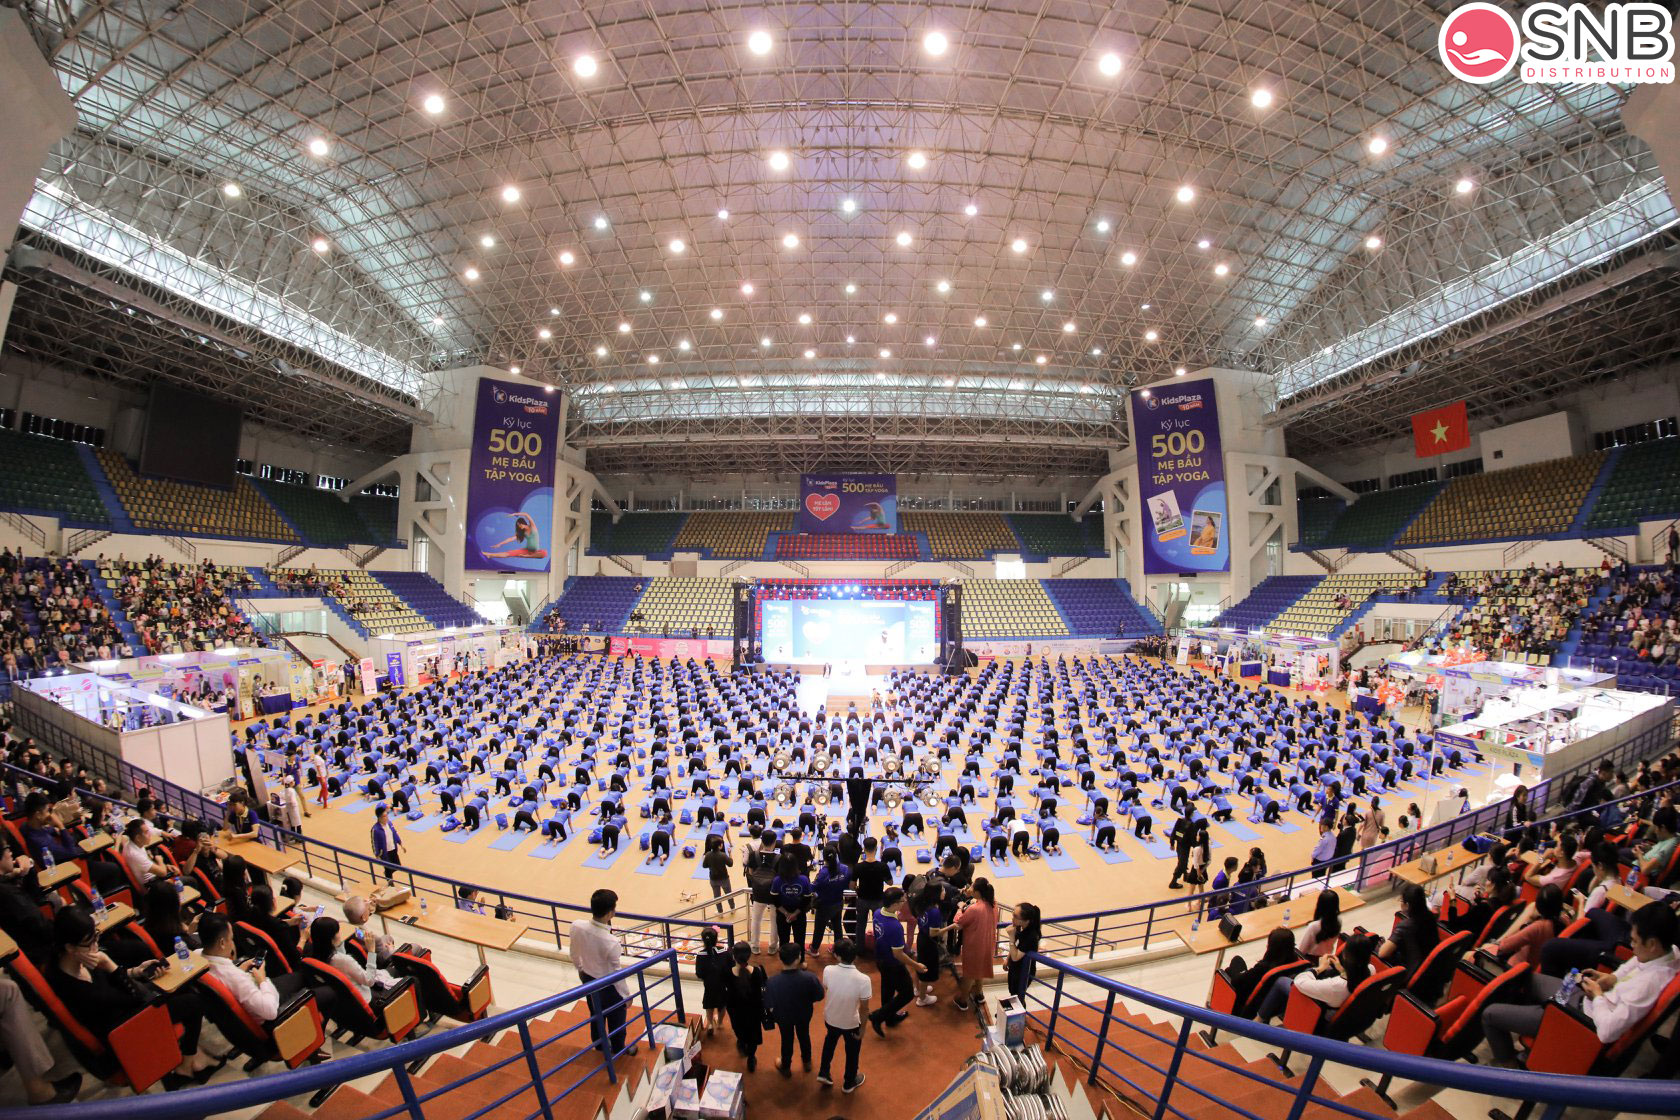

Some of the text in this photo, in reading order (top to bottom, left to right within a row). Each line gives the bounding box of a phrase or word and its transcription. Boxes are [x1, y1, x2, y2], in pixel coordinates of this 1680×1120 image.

[508, 395, 548, 407] KidsPlaza
[1161, 394, 1202, 406] KidsPlaza
[517, 418, 532, 429] lục
[1175, 419, 1190, 429] lục
[488, 428, 542, 456] 500
[1152, 429, 1205, 457] 500
[492, 456, 509, 468] MẸ
[1158, 454, 1202, 471] MẸ BẦU
[484, 467, 541, 483] TẬP YOGA
[1152, 470, 1210, 486] TẬP YOGA
[842, 482, 864, 492] 500
